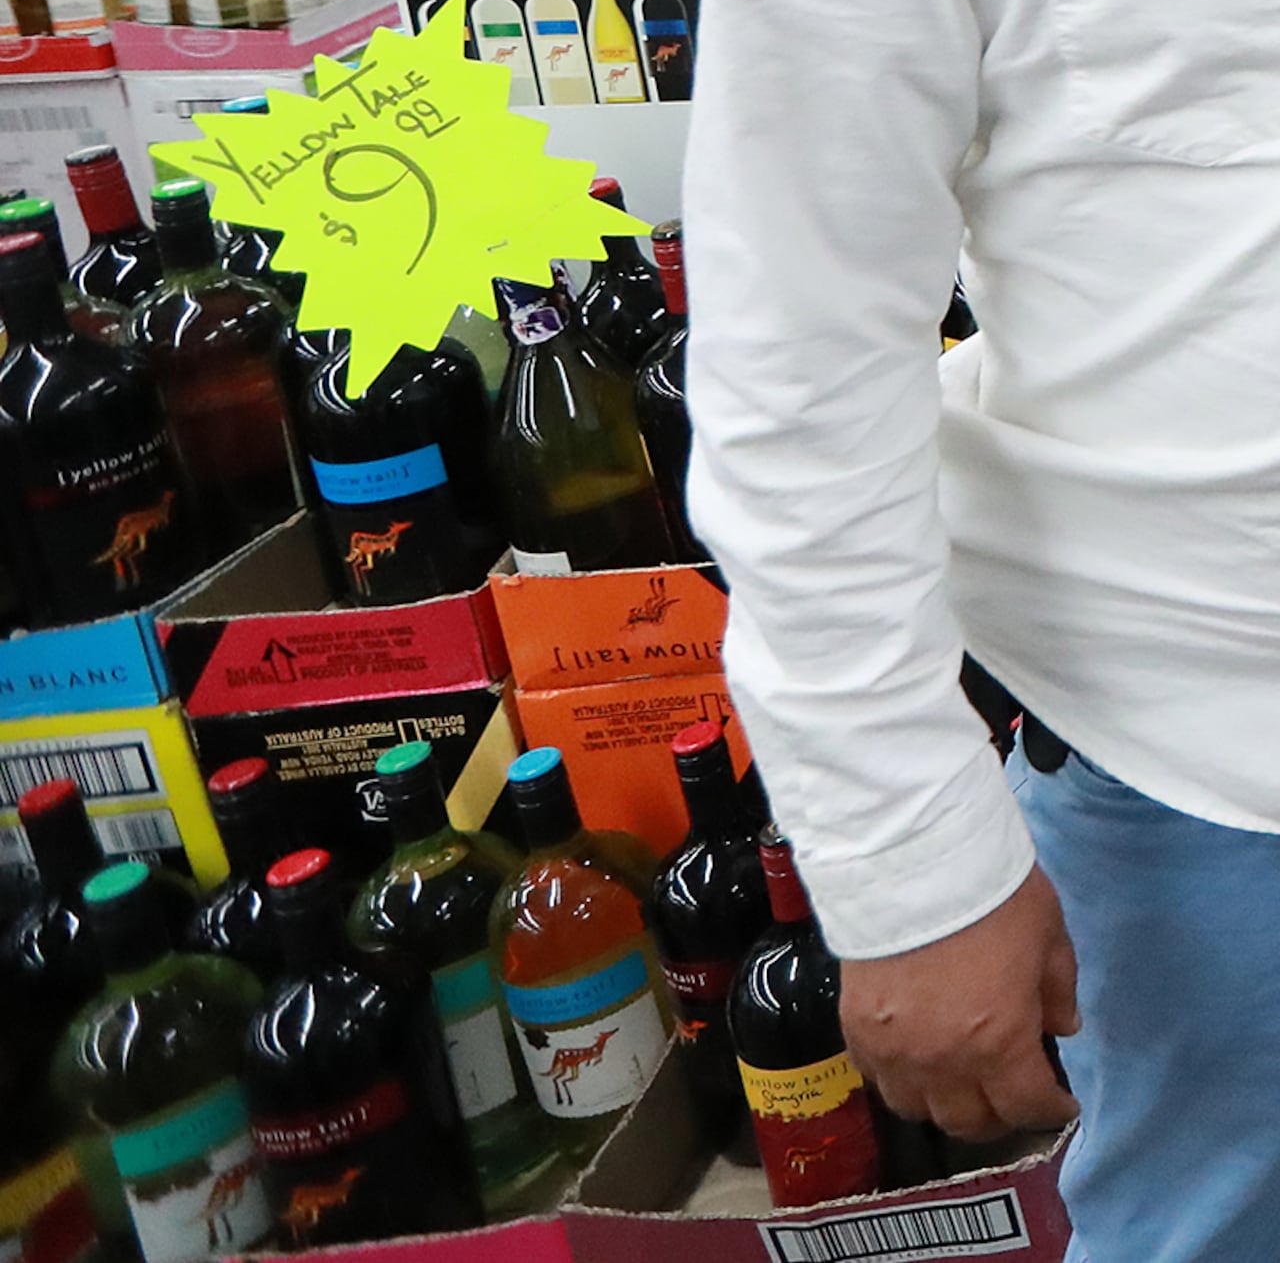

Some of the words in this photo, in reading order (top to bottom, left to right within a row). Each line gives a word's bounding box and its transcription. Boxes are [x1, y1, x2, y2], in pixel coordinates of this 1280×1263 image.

[395, 98, 461, 138] 99
[191, 113, 356, 205] YELLOW
[29, 665, 128, 691] BLANC
[631, 700, 646, 711] OF
[650, 694, 696, 707] PRODUCT
[572, 701, 629, 718] AUSTRALIA
[349, 720, 395, 737] PRODUCT
[419, 714, 465, 730] BOTTLES
[265, 729, 325, 746] AUSTRALIA
[327, 726, 340, 738] OF
[761, 1089, 824, 1110] Sangria
